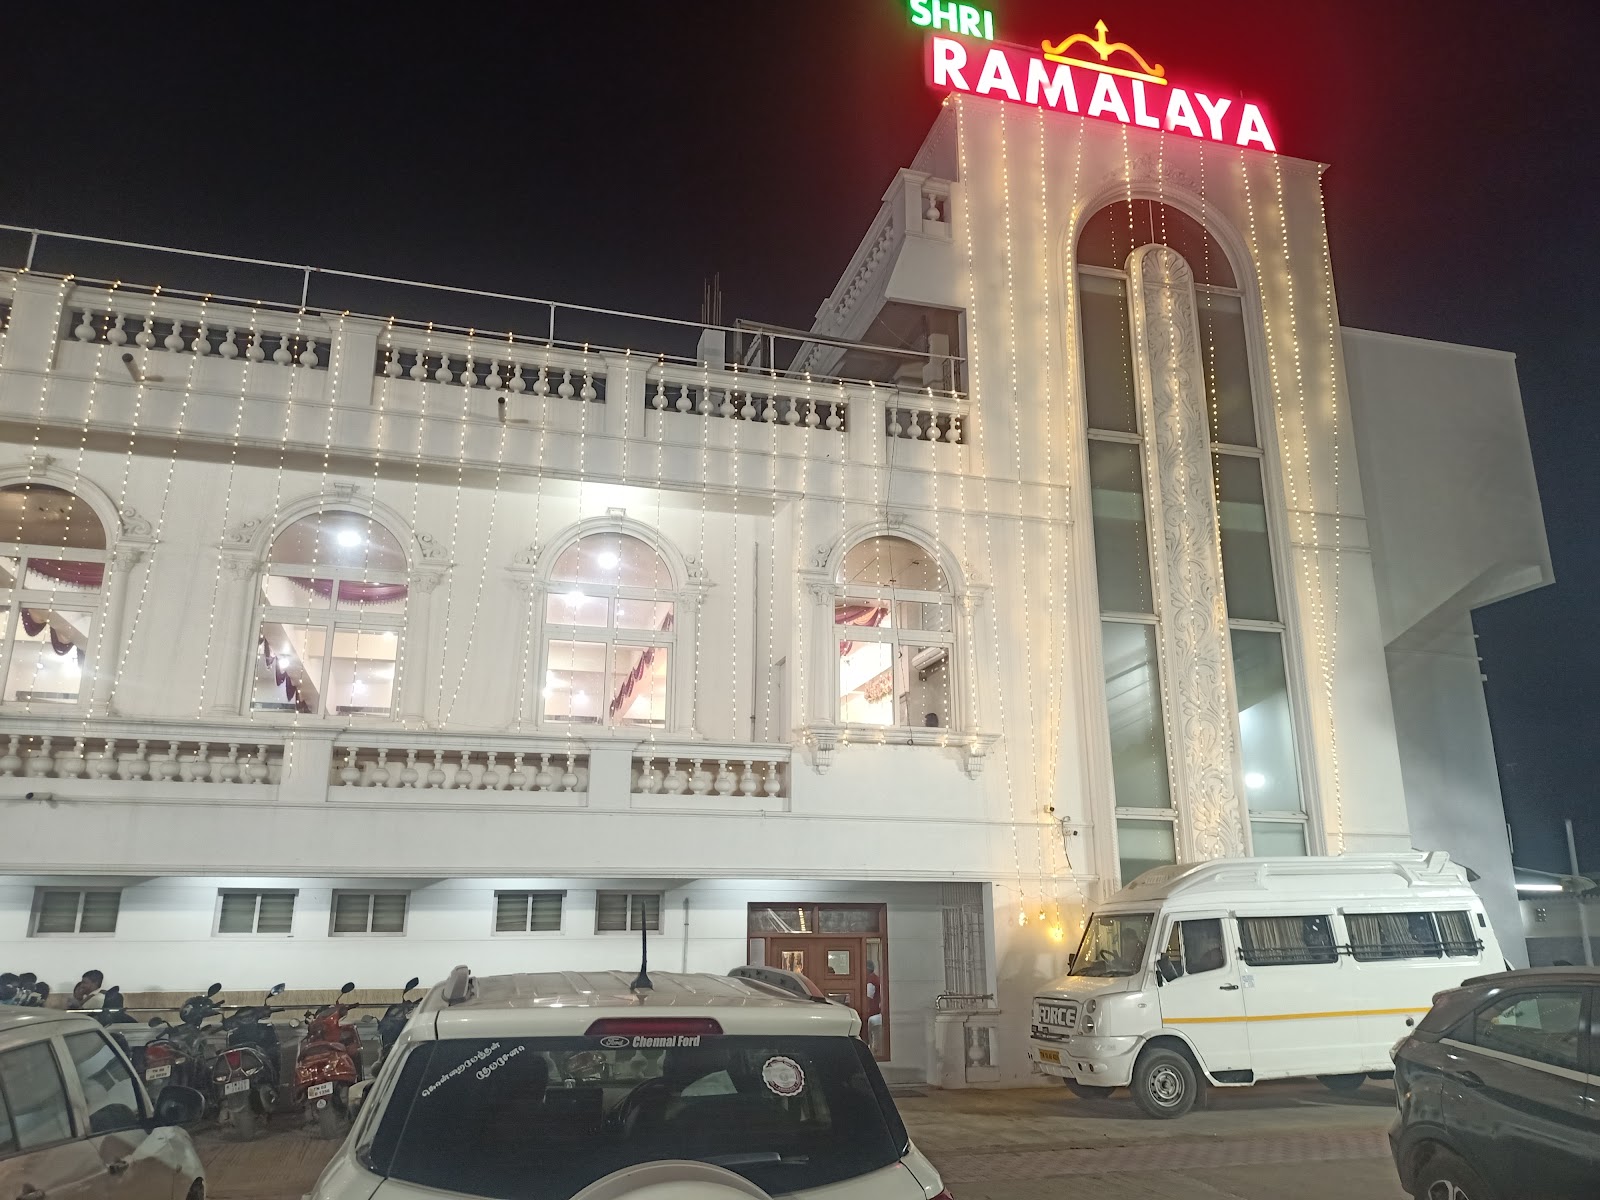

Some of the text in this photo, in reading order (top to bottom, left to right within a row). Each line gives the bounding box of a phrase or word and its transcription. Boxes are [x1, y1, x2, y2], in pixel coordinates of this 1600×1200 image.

[909, 0, 994, 41] SHRI
[932, 36, 1277, 152] RAMALAYA
[1039, 1006, 1076, 1027] FORCE
[632, 1035, 701, 1048] Chennai Ford
